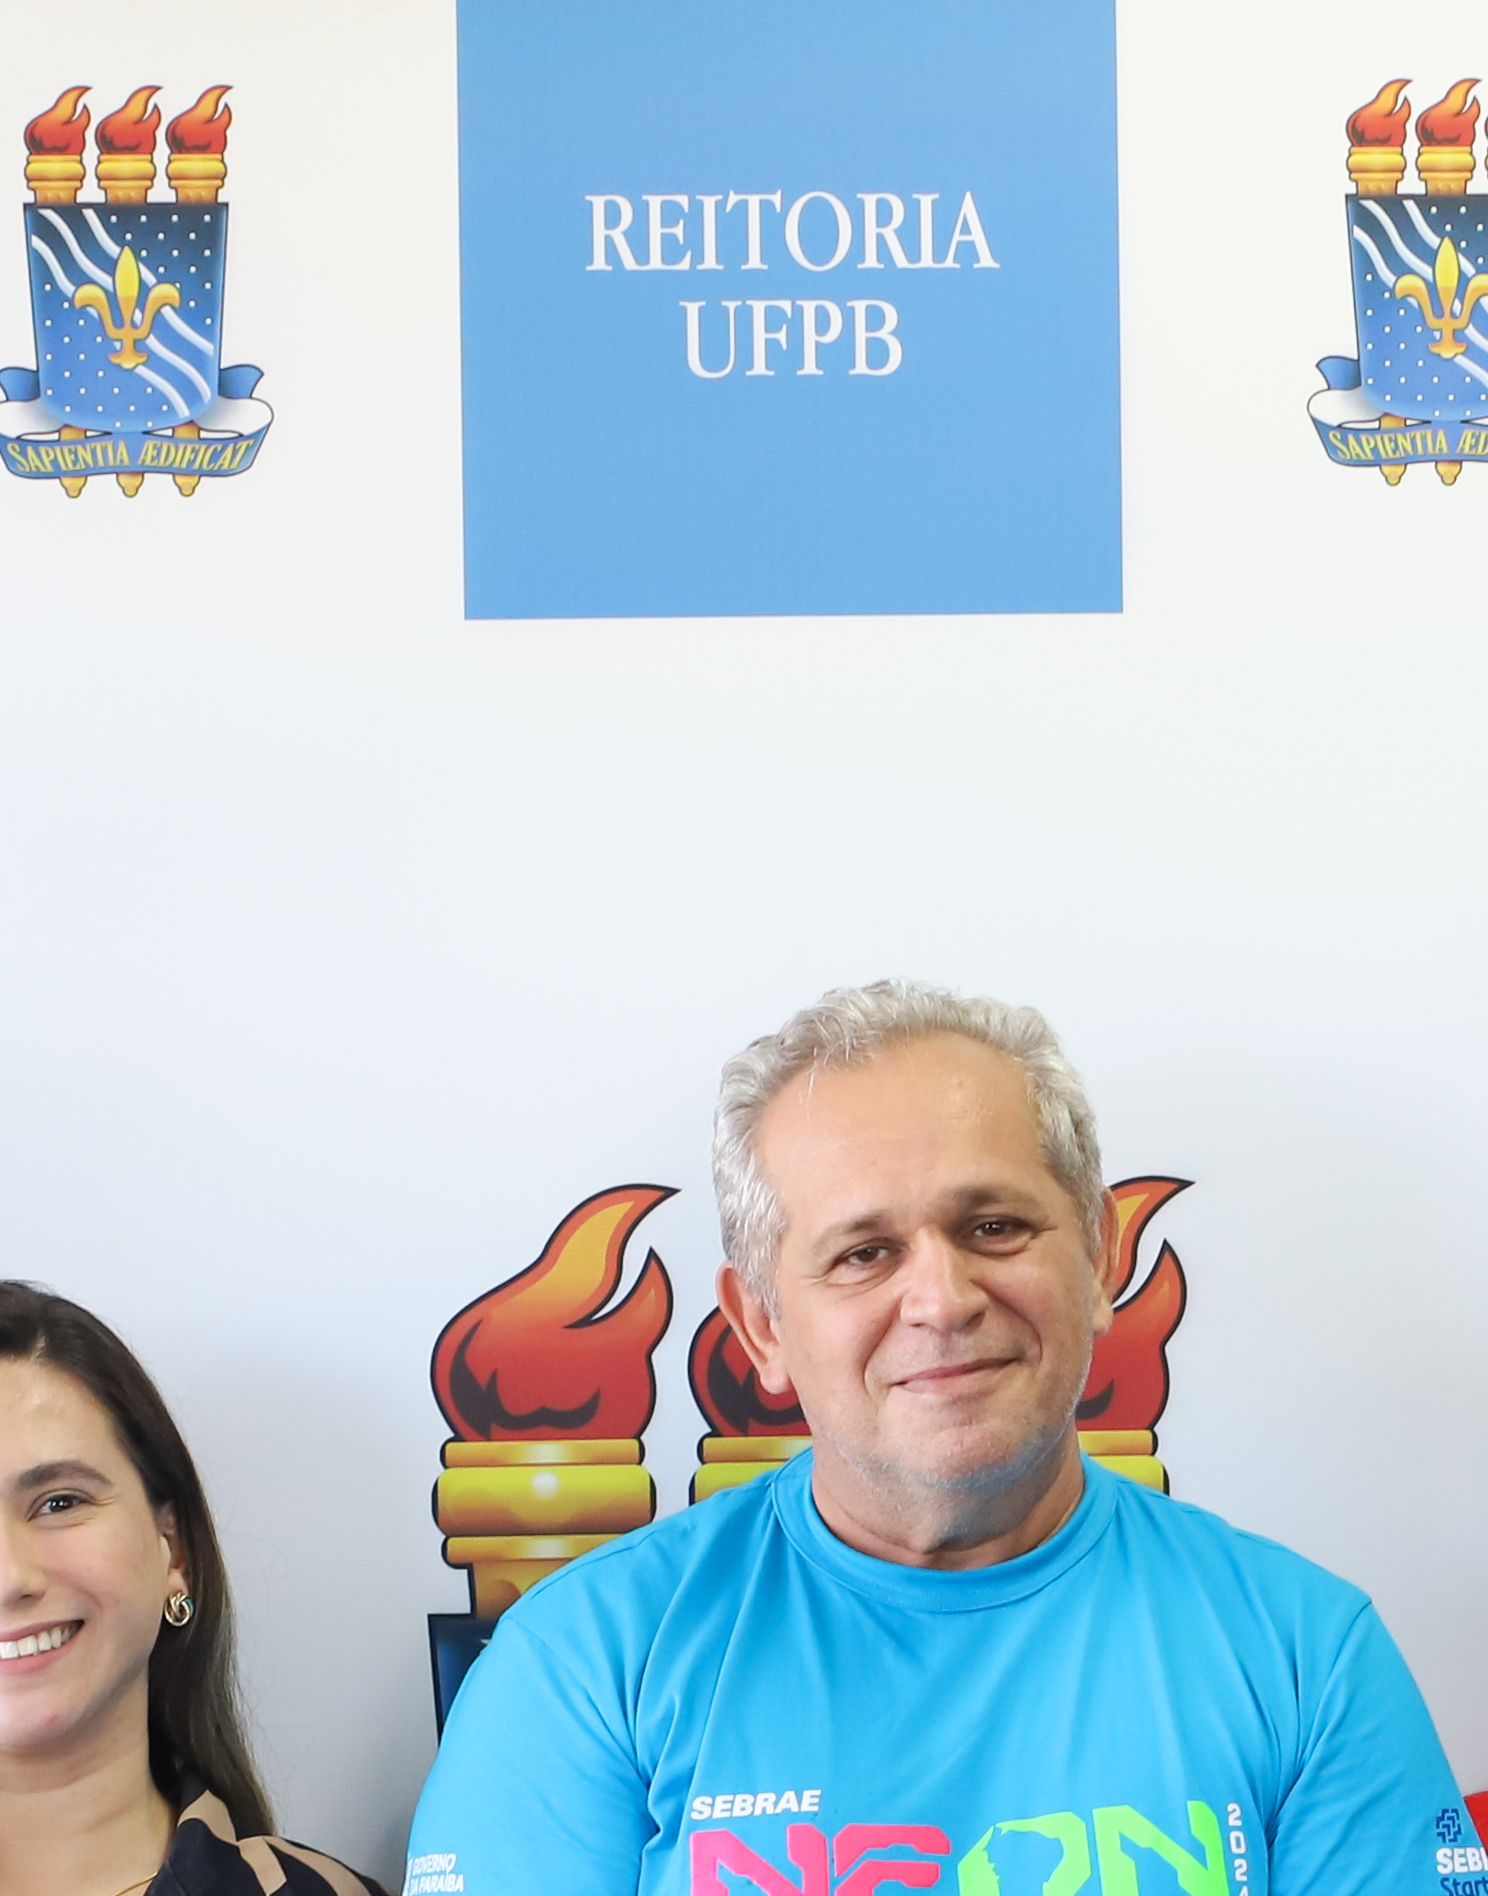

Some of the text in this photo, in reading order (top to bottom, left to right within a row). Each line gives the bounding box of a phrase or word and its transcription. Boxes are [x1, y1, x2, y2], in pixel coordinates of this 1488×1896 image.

[585, 190, 999, 271] REITORIA
[680, 300, 902, 378] UFPB
[7, 441, 131, 473] SAPIENTIA
[1328, 429, 1450, 461] SAPIENTIA
[690, 1790, 821, 1820] SEBRAE
